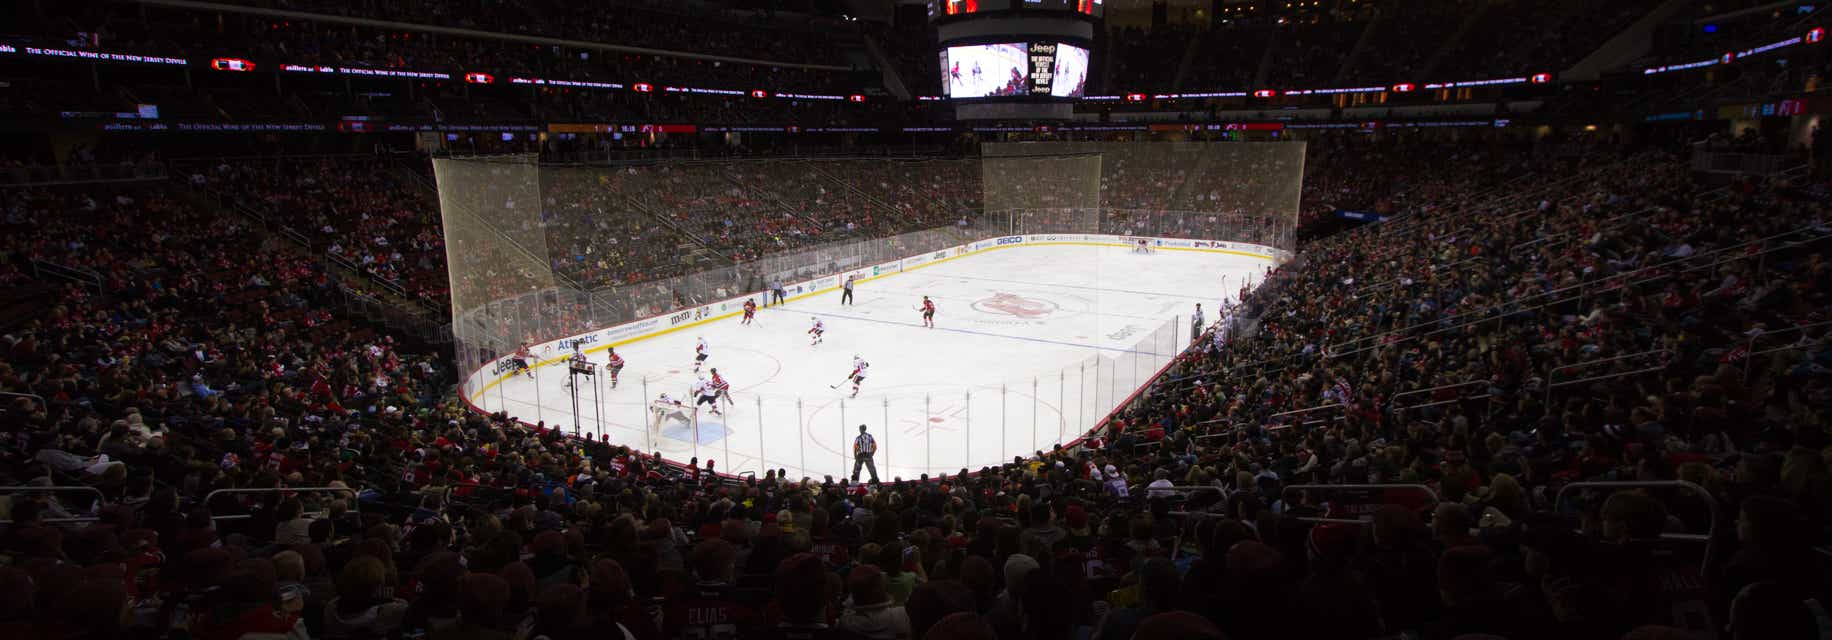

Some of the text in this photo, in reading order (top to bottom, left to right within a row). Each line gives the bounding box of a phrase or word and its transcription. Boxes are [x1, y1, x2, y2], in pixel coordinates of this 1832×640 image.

[43, 48, 78, 58] OFFICIAL
[78, 51, 99, 59] WINE
[1030, 43, 1055, 54] Jeep
[997, 236, 1022, 245] GEICO
[558, 334, 598, 351] Atltic
[688, 607, 728, 625] ELIAS
